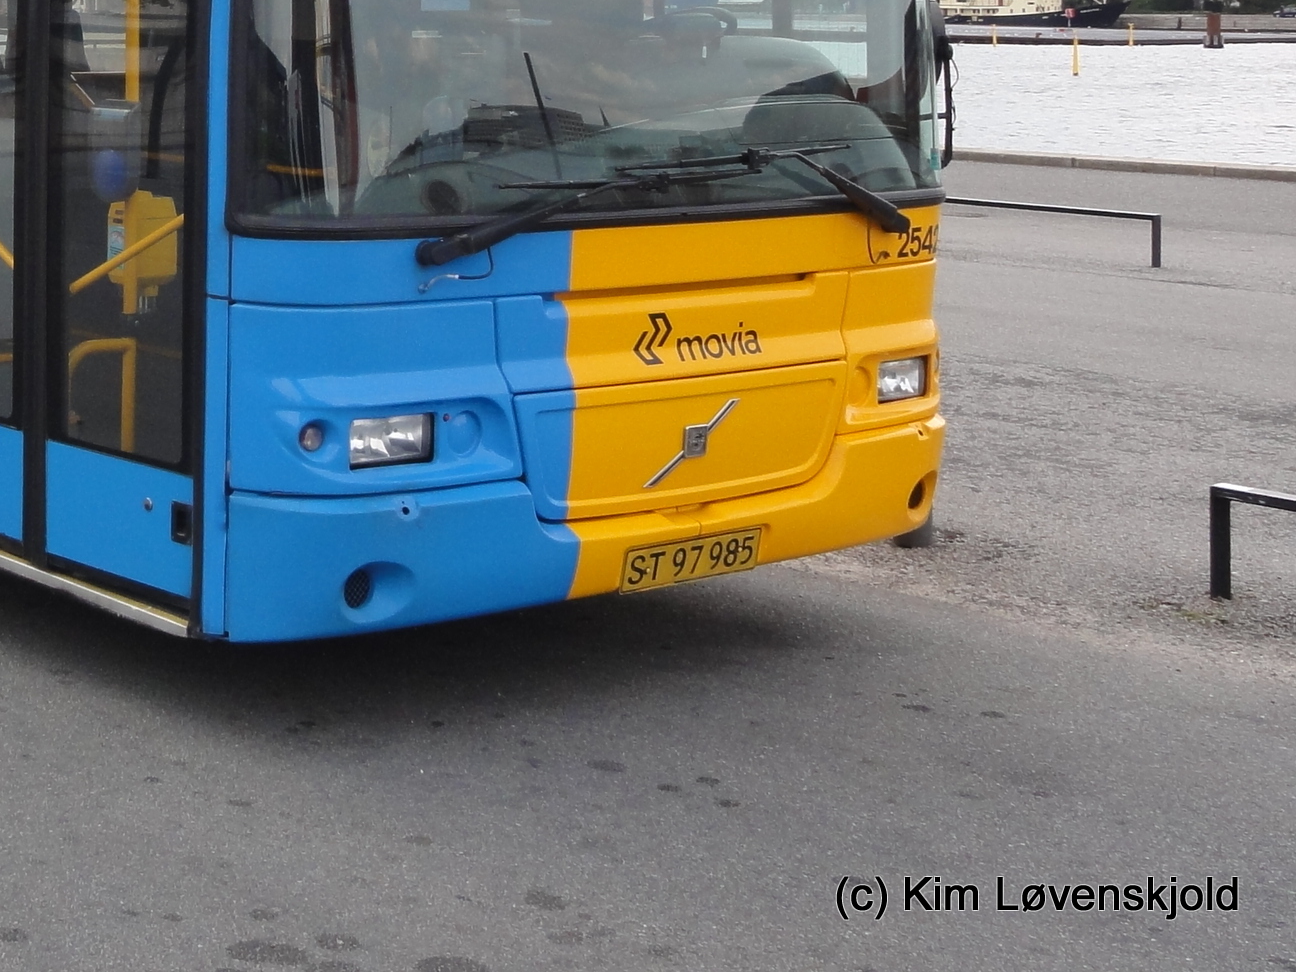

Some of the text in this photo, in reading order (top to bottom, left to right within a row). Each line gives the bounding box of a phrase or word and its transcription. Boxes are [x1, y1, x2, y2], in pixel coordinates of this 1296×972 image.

[676, 321, 762, 361] movia
[627, 536, 754, 585] ST 97 985
